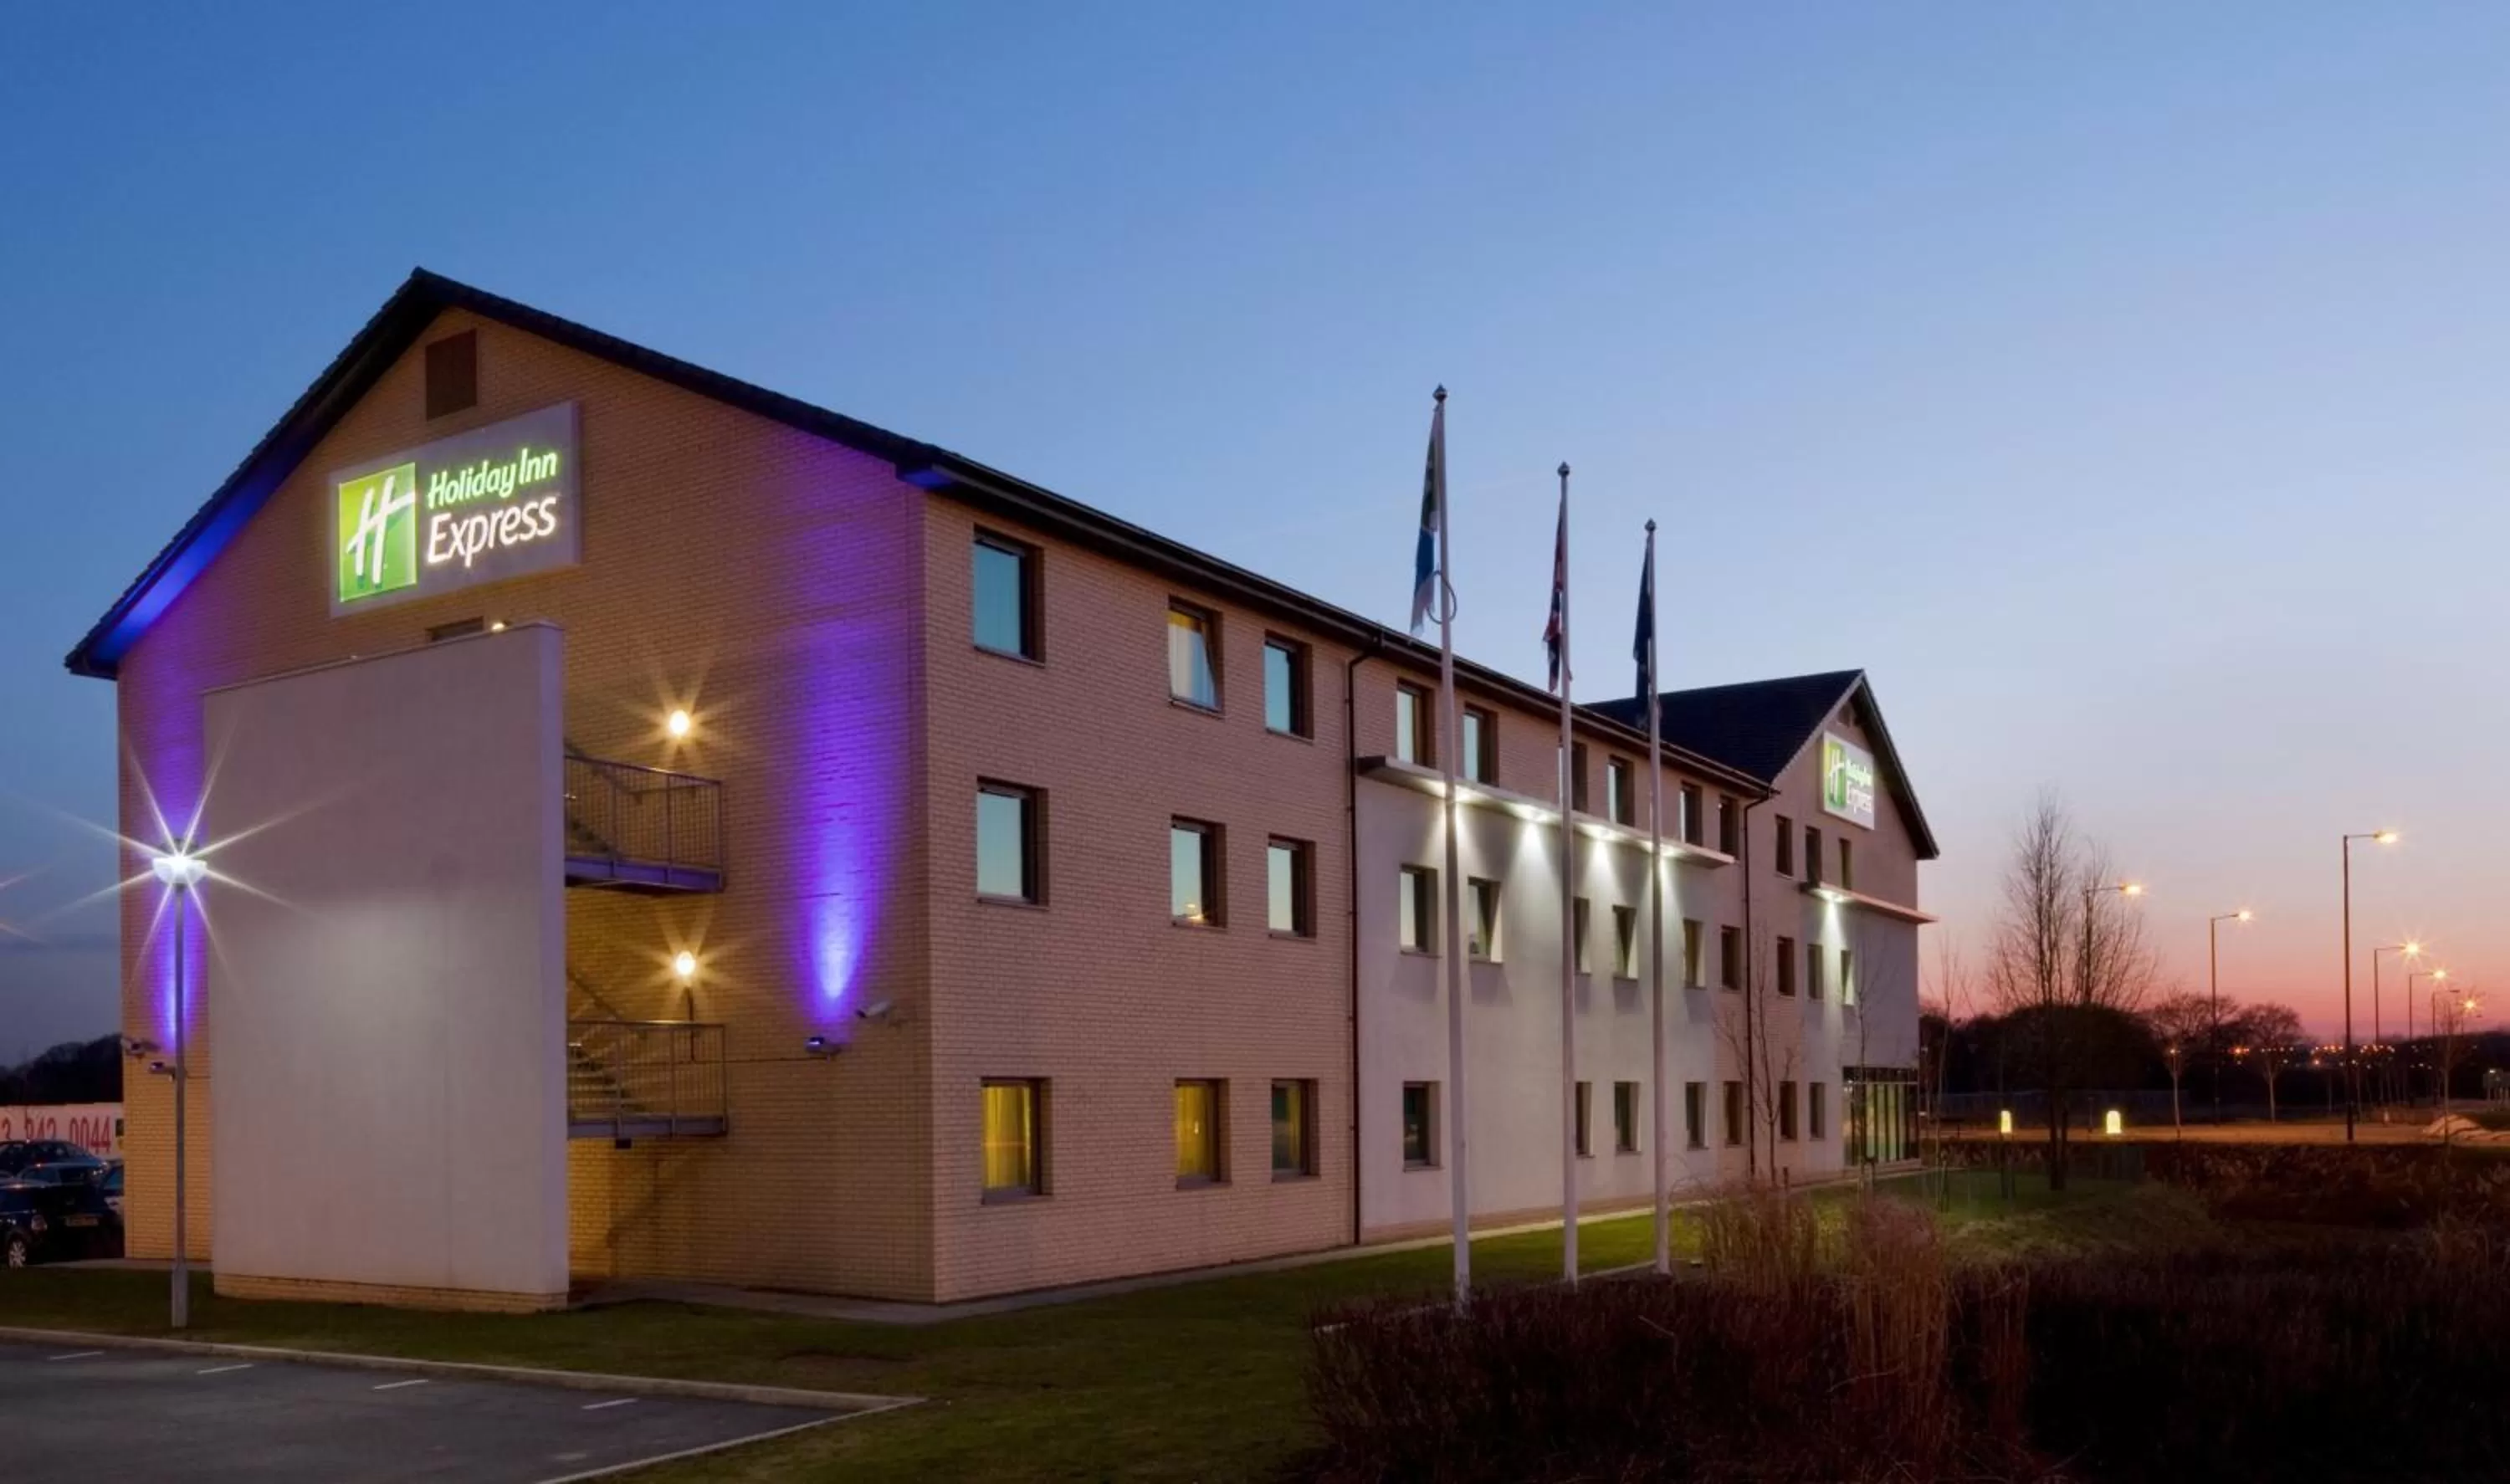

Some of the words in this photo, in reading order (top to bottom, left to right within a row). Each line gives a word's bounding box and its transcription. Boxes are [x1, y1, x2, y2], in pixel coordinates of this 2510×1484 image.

[428, 459, 516, 509] Holiday
[518, 448, 558, 484] Inn
[346, 474, 416, 584] H
[427, 496, 557, 568] Express
